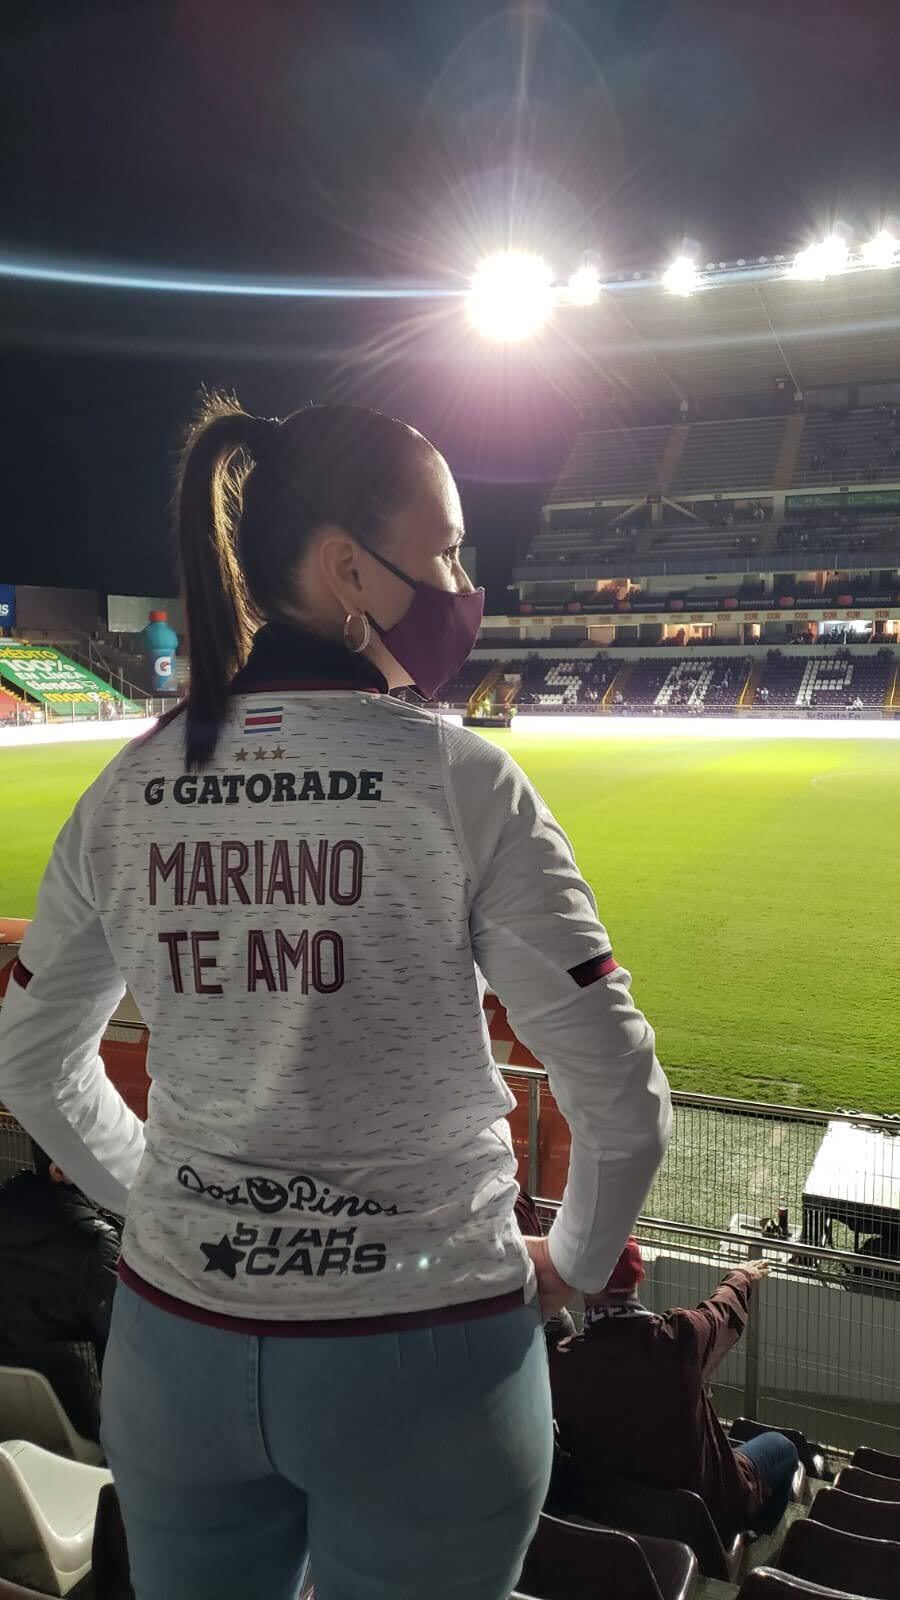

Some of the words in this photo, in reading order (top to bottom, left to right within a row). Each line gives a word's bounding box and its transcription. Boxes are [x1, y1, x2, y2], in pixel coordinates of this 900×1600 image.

[15, 672, 40, 681] EN
[154, 656, 171, 676] G
[25, 680, 84, 690] tienda
[173, 770, 384, 805] GATORADE
[148, 839, 364, 906] MARIANO
[158, 930, 224, 995] TE
[247, 929, 346, 996] AMO
[177, 1164, 249, 1206] Dos
[287, 1175, 417, 1217] Pinos
[245, 1243, 387, 1277] CARS
